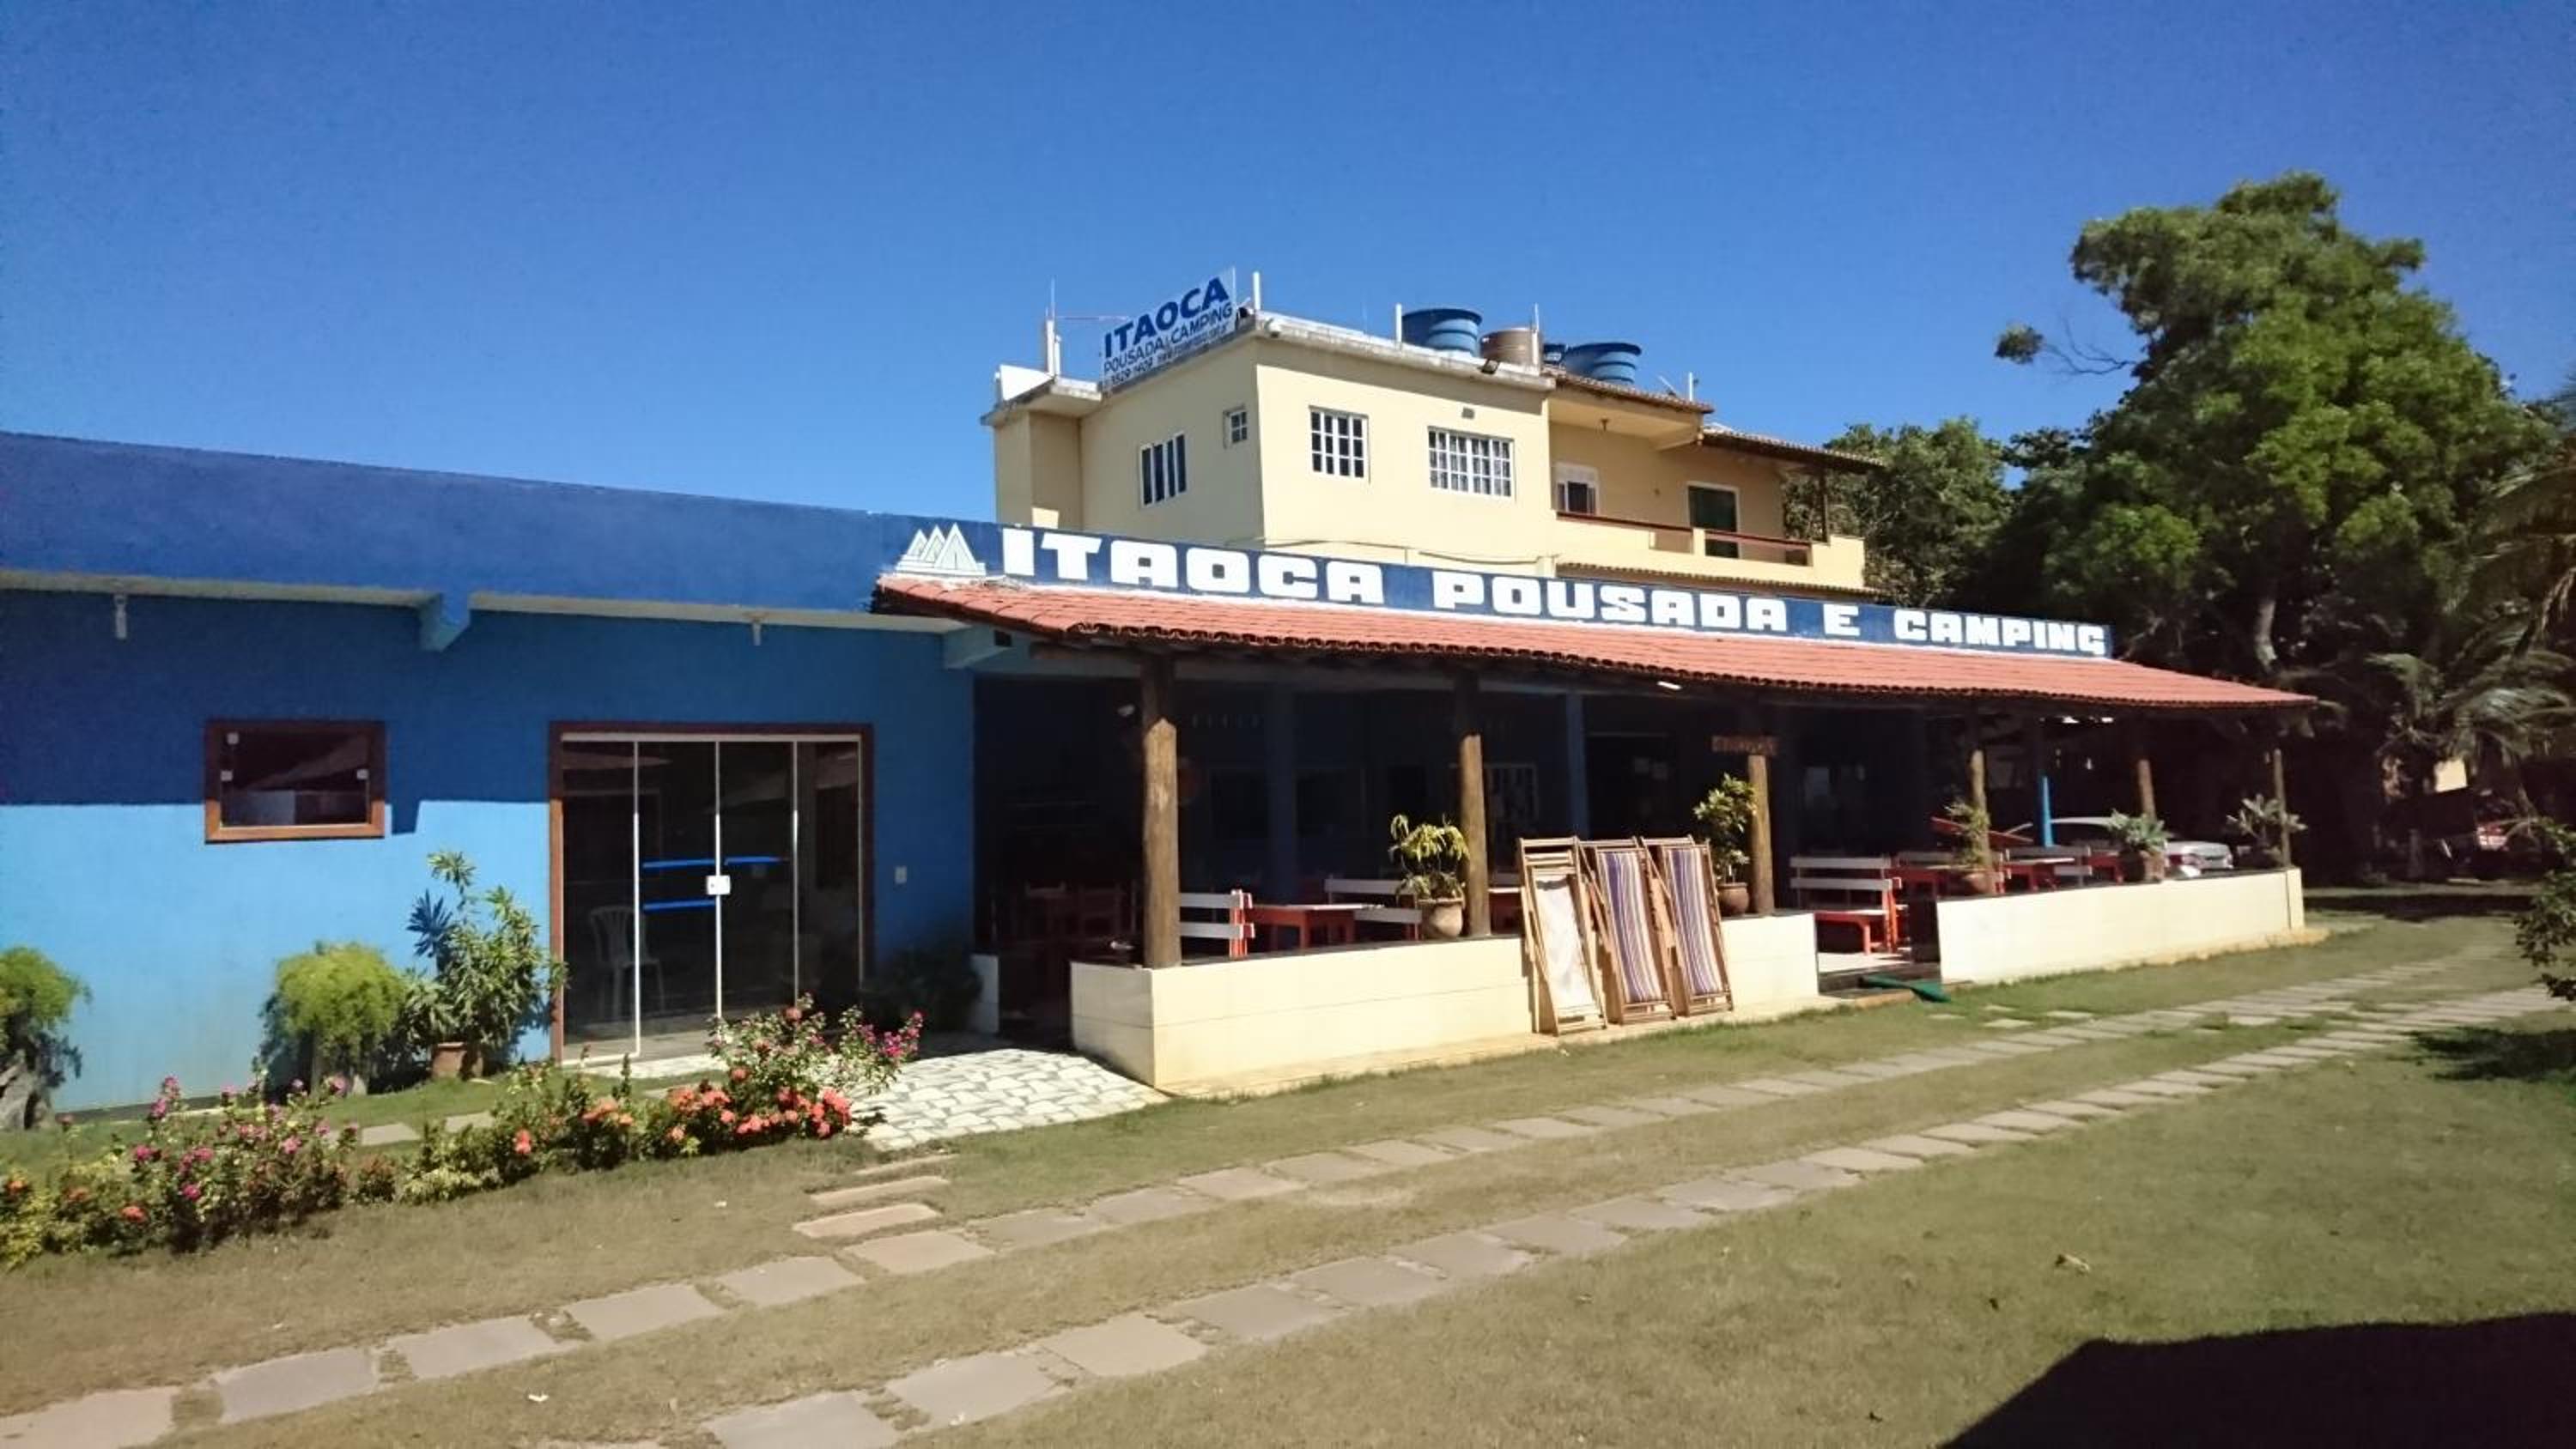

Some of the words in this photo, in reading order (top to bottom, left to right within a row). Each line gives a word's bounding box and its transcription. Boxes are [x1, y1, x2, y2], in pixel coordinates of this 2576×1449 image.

[1103, 276, 1230, 359] ITAOCA
[1103, 336, 1164, 376] POUSADA
[1170, 301, 1233, 344] CAMPING
[1002, 527, 1384, 604] ITAOCA
[1431, 570, 1788, 632] POUSADA
[1823, 603, 1861, 637] E
[1893, 609, 2105, 656] CAMPING
